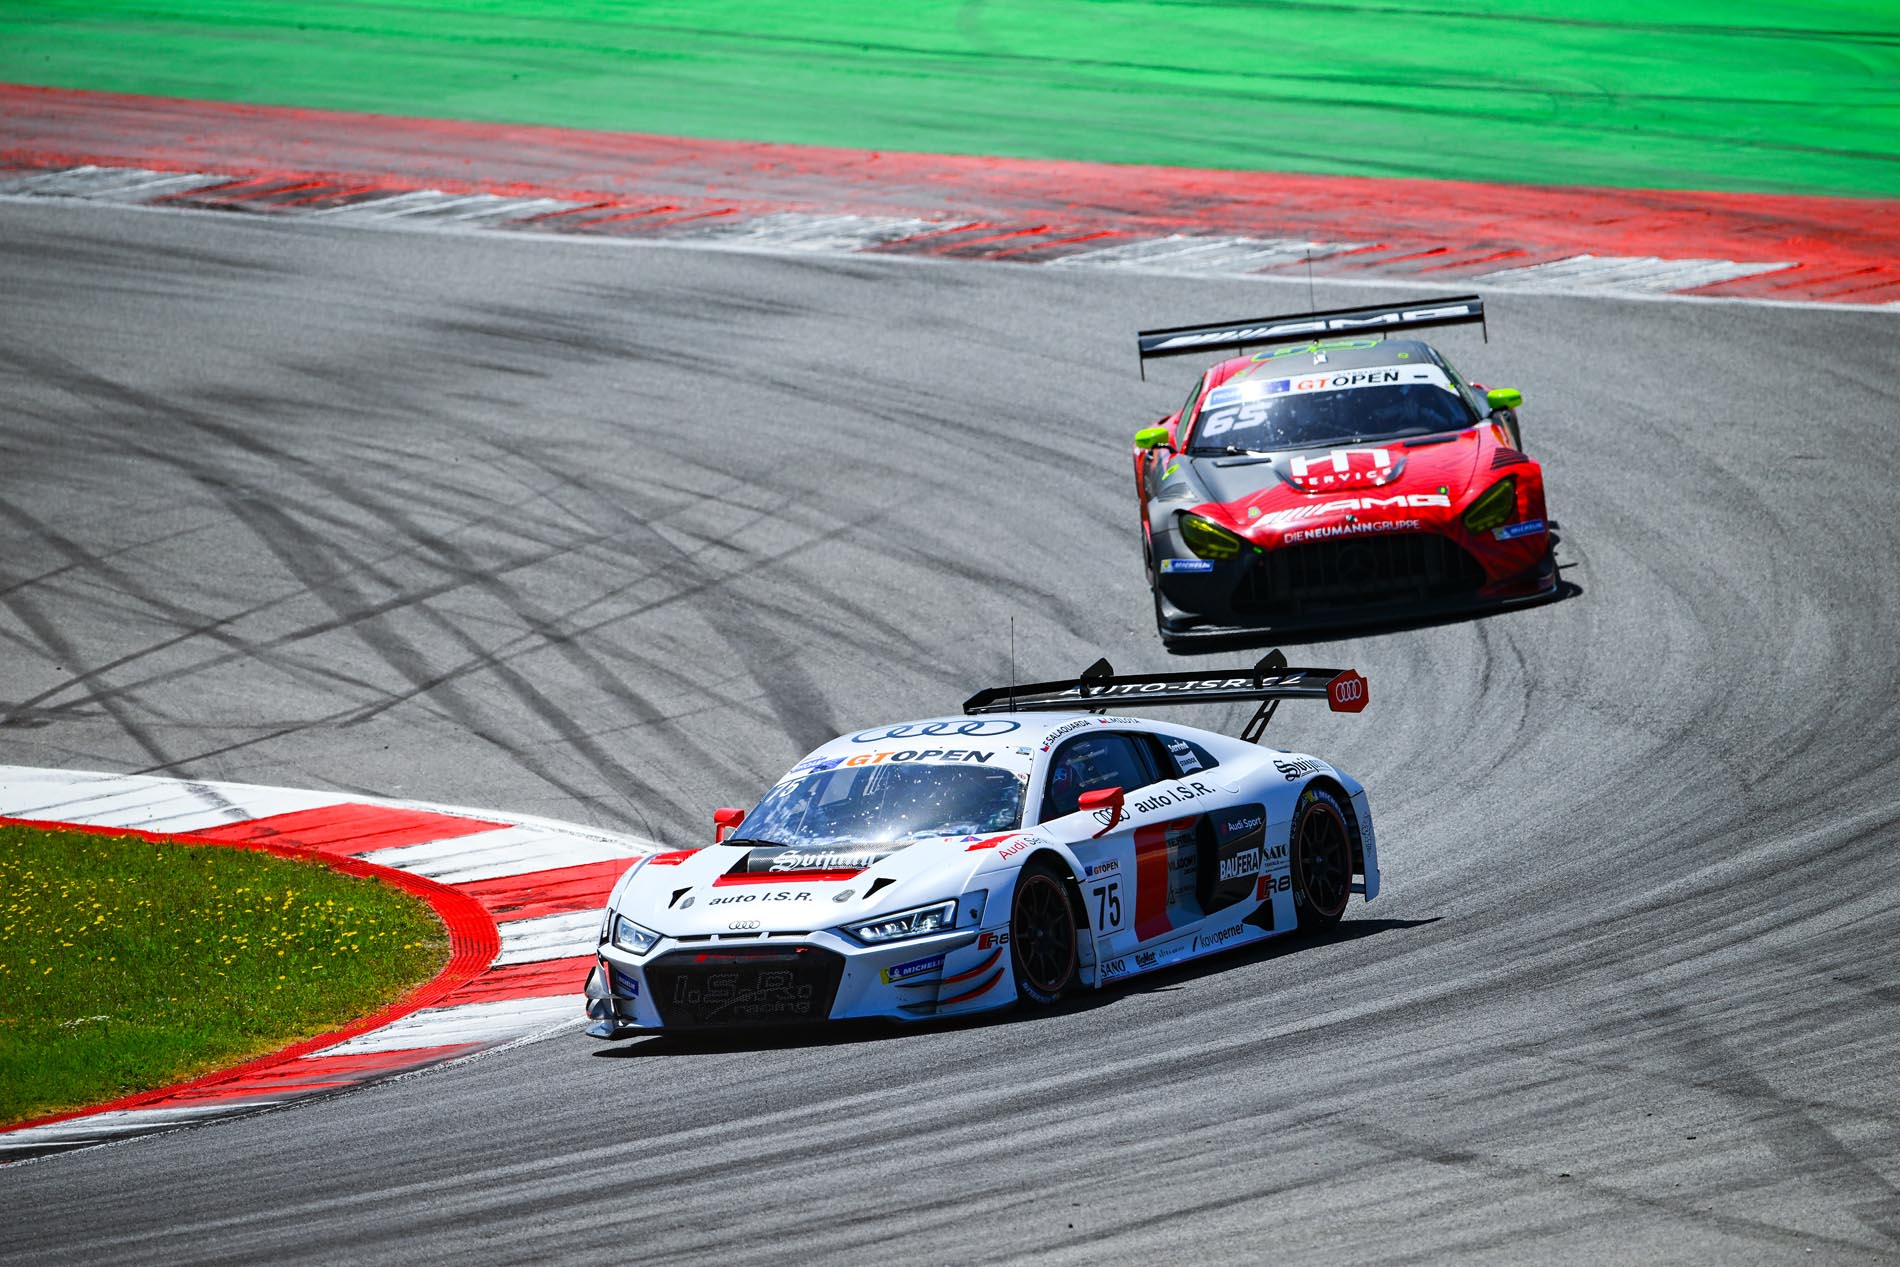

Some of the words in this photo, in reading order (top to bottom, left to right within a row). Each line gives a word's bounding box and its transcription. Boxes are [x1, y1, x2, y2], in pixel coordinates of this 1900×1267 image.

[1202, 402, 1272, 437] 65
[1134, 795, 1172, 813] auto
[1167, 782, 1216, 802] I.S.R.
[1228, 820, 1243, 831] Audi
[1243, 816, 1262, 829] Sport
[998, 839, 1028, 860] Audi
[1220, 851, 1260, 878] BAUFERA
[1264, 875, 1290, 897] R8
[708, 892, 756, 906] auto
[761, 891, 813, 902] I.S.R.
[1093, 882, 1121, 931] 75
[987, 932, 1009, 947] R8
[1200, 924, 1245, 948] kovoperner
